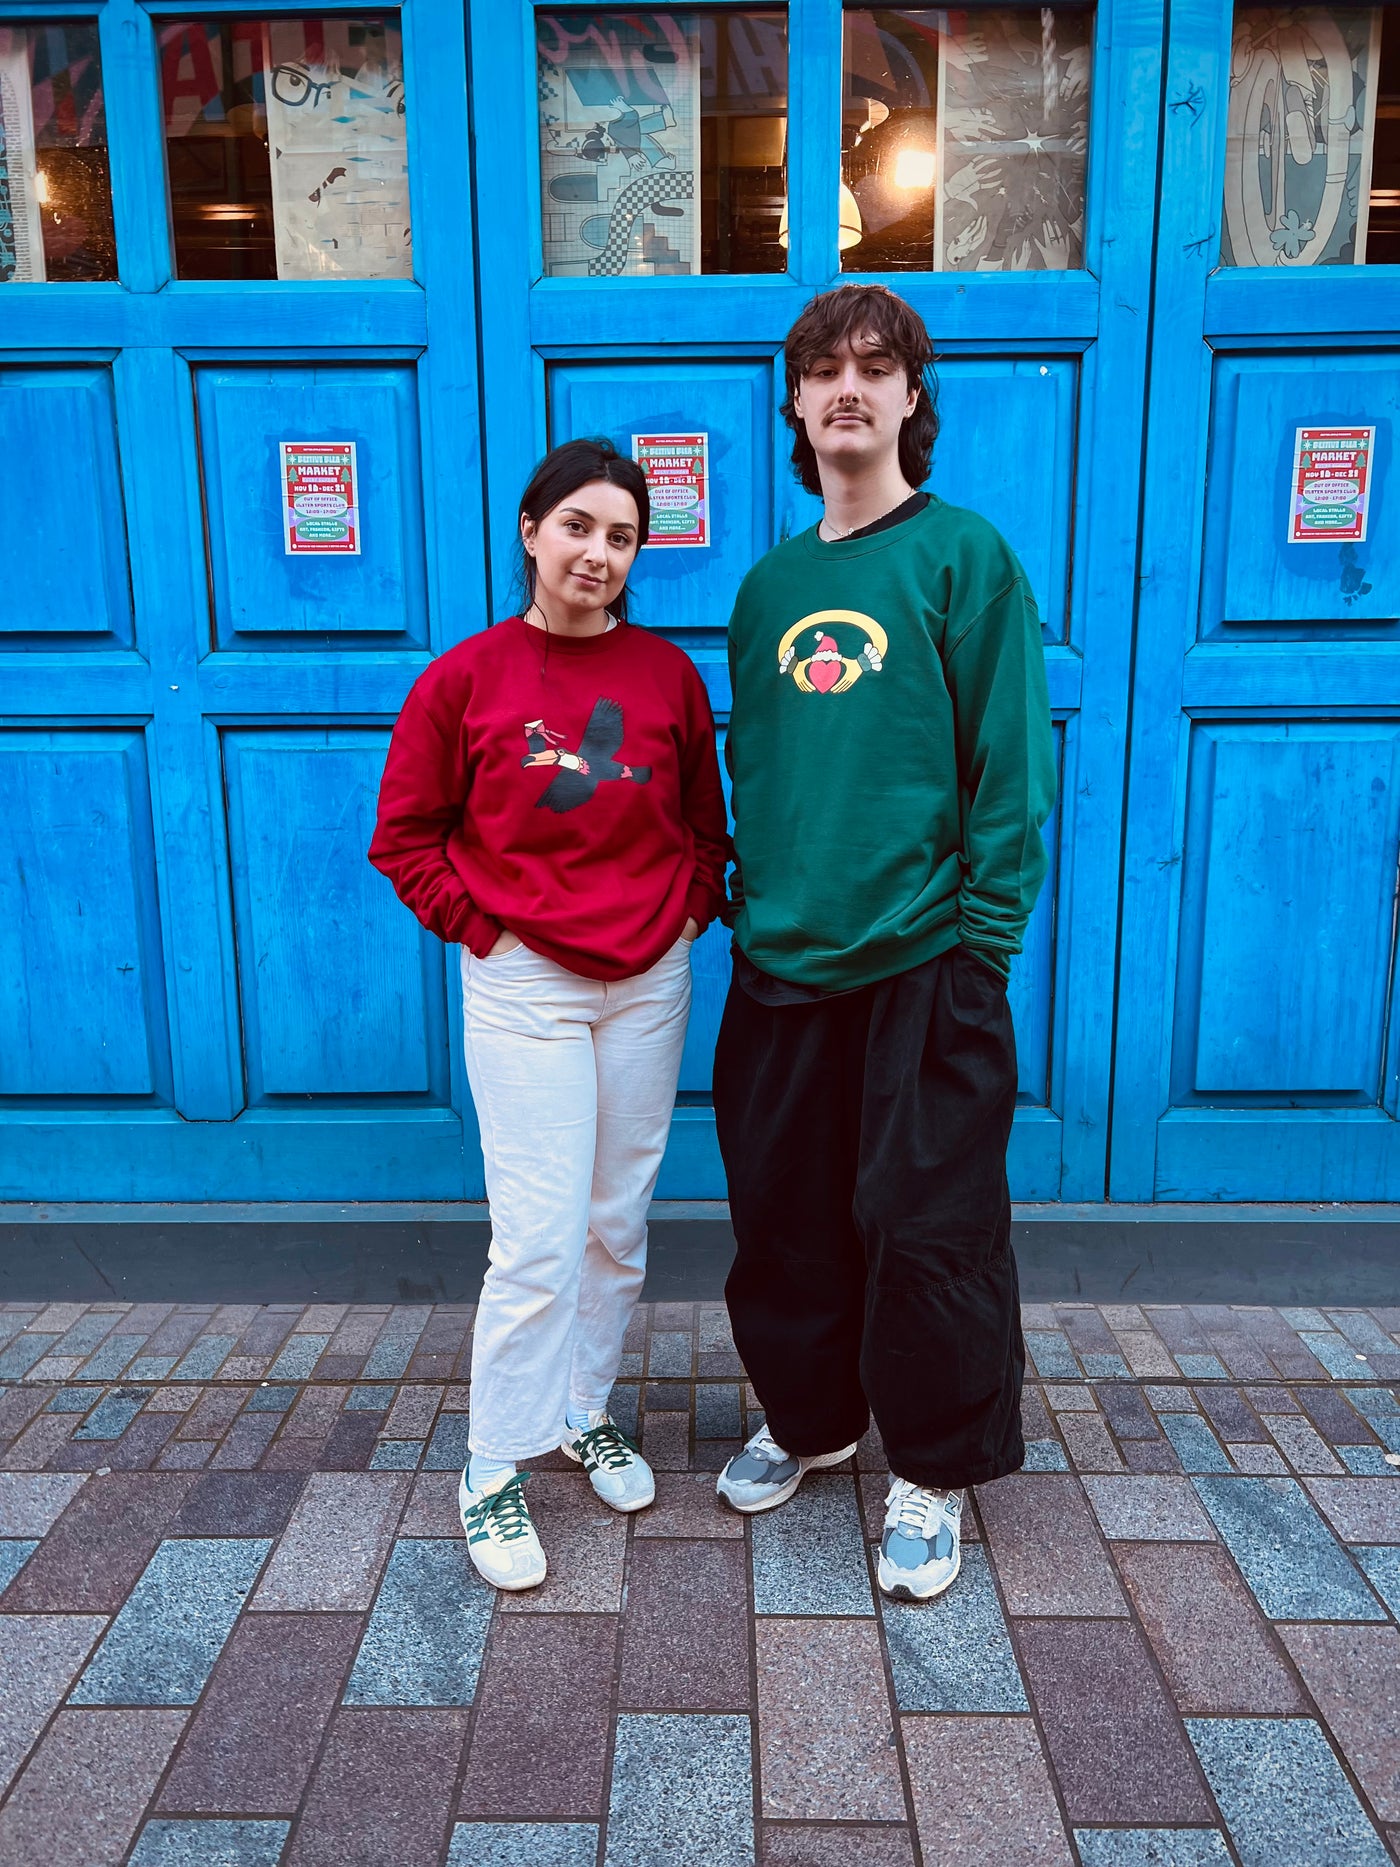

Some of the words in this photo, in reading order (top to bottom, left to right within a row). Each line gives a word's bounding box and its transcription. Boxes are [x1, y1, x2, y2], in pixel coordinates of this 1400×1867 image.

[1312, 452, 1357, 461] MARKET
[650, 458, 693, 468] MARKET
[298, 467, 341, 475] MARKET
